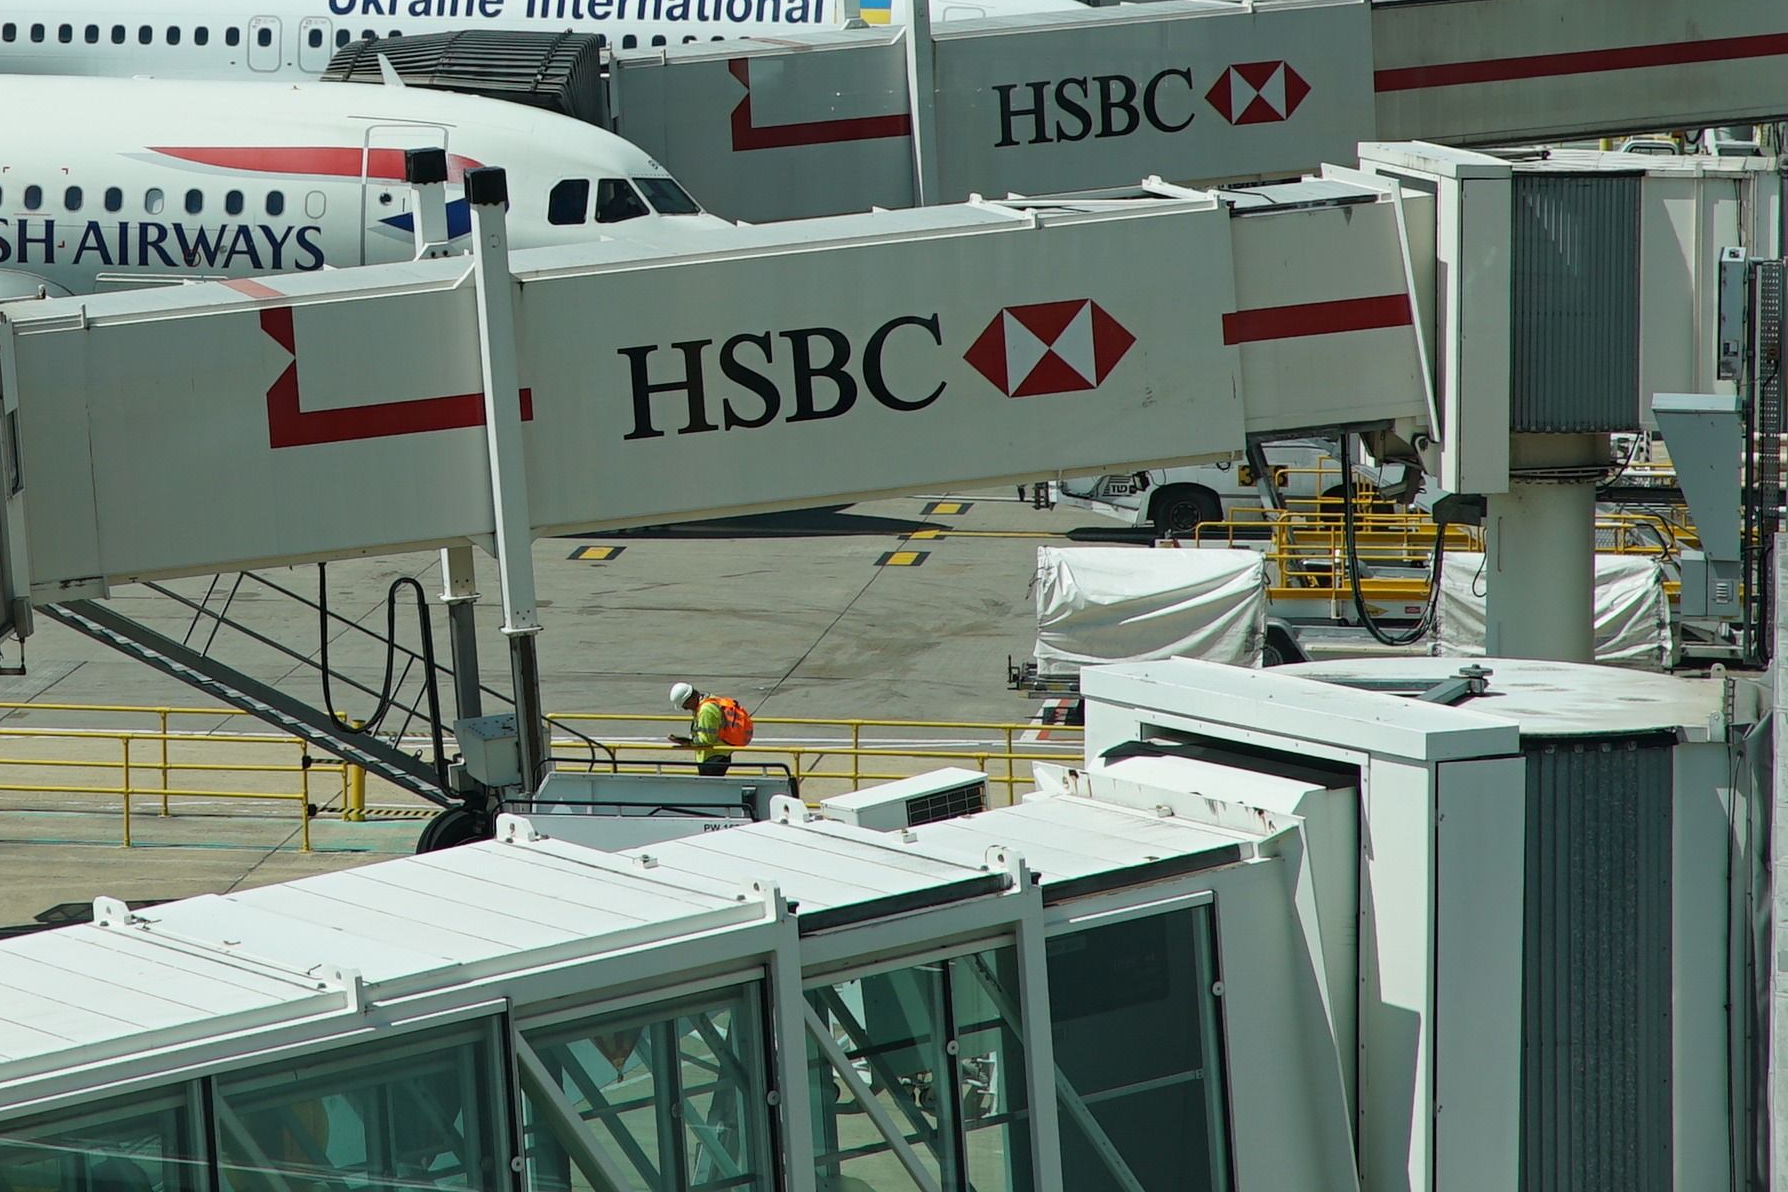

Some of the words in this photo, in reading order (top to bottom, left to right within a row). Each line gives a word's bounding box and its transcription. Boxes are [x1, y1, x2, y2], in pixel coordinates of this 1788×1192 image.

[992, 67, 1195, 148] HSBC
[72, 220, 326, 271] AIRWAYS
[617, 313, 947, 440] HSBC
